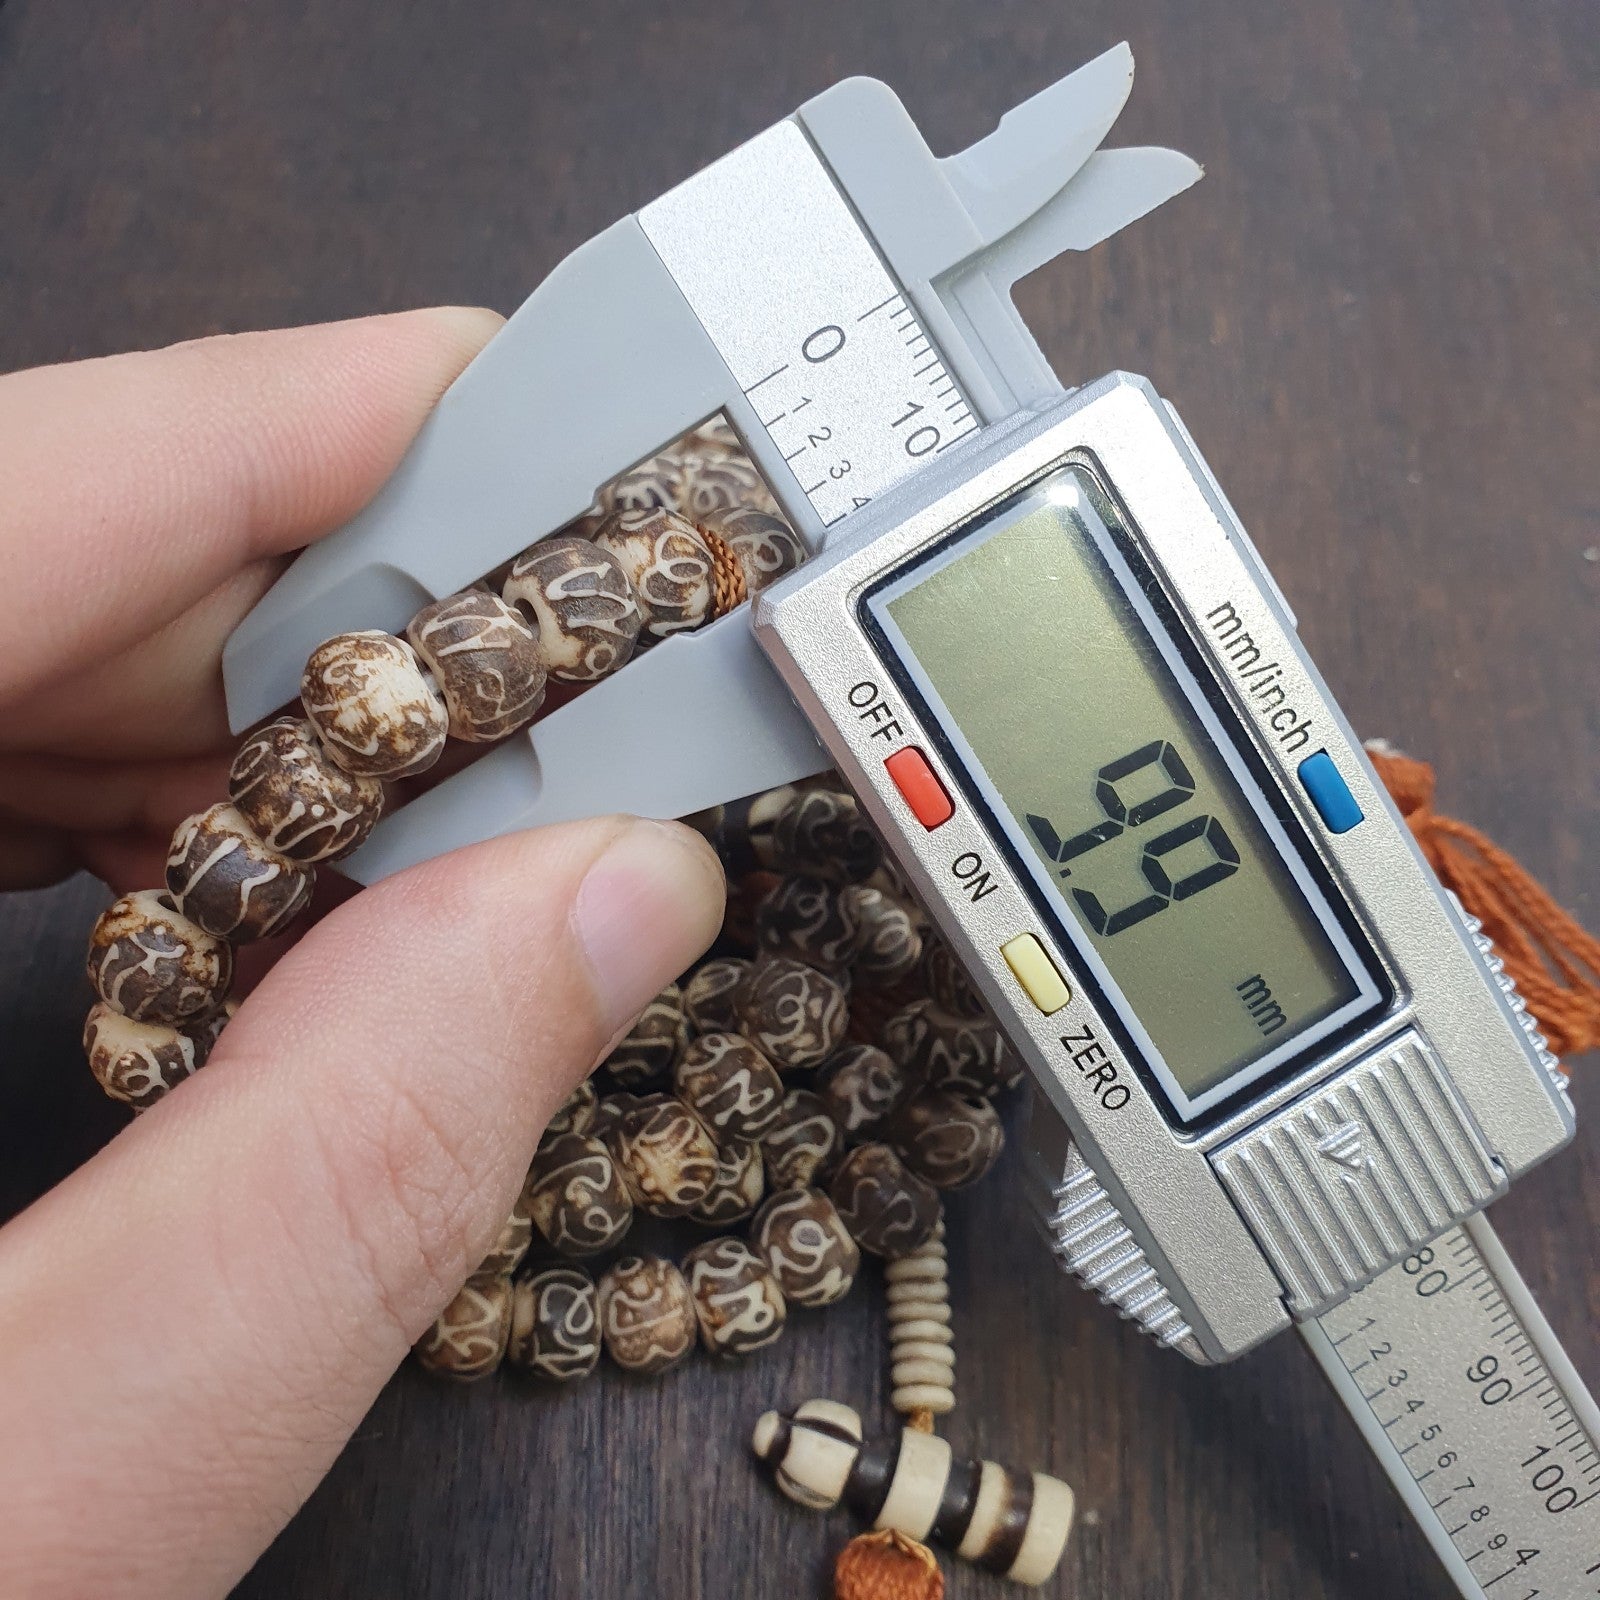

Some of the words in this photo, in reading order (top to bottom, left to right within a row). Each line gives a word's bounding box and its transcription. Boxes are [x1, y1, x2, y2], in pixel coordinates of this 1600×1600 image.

[801, 325, 846, 363] 0
[792, 397, 812, 413] 1
[808, 427, 832, 448] 2
[891, 401, 941, 457] 10
[829, 460, 852, 480] 3
[1206, 600, 1313, 754] mm/inch
[847, 681, 904, 742] OFF
[951, 851, 998, 902] ON
[1237, 974, 1288, 1036] mm
[1060, 1025, 1131, 1110] ZERO
[1402, 1247, 1449, 1297] 80
[1358, 1317, 1376, 1332] 1
[1371, 1341, 1392, 1361] 2
[1388, 1368, 1408, 1388] 3
[1467, 1355, 1513, 1406] 90
[1406, 1399, 1425, 1413] 4
[1421, 1424, 1442, 1441] 5
[1438, 1451, 1458, 1468] 6
[1453, 1476, 1475, 1491] 7
[1521, 1445, 1578, 1513] 100
[1470, 1505, 1490, 1522] 8
[1488, 1533, 1508, 1550] 9
[1516, 1549, 1540, 1566] 4
